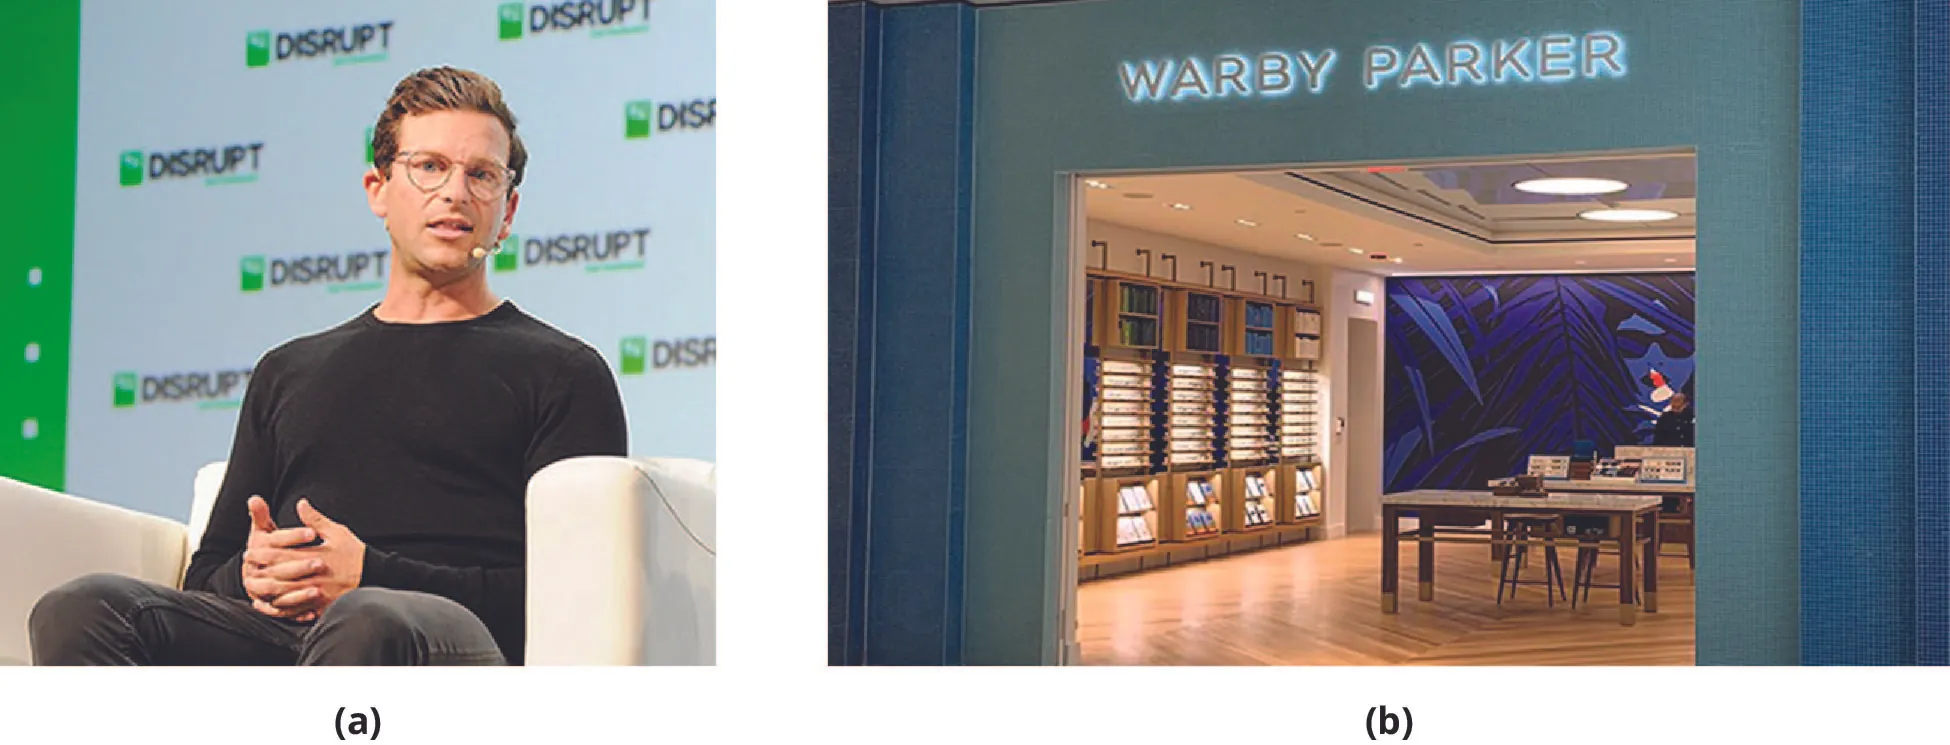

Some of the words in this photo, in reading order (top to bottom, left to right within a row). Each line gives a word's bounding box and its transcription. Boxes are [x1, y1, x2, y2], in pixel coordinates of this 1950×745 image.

[276, 20, 394, 60] DISRUPT
[1119, 48, 1337, 101] WARBY
[1362, 31, 1628, 89] PARKER
[149, 142, 265, 180] DISRUPT
[525, 227, 650, 266] DISRUPT
[271, 250, 389, 286] DISRUPT
